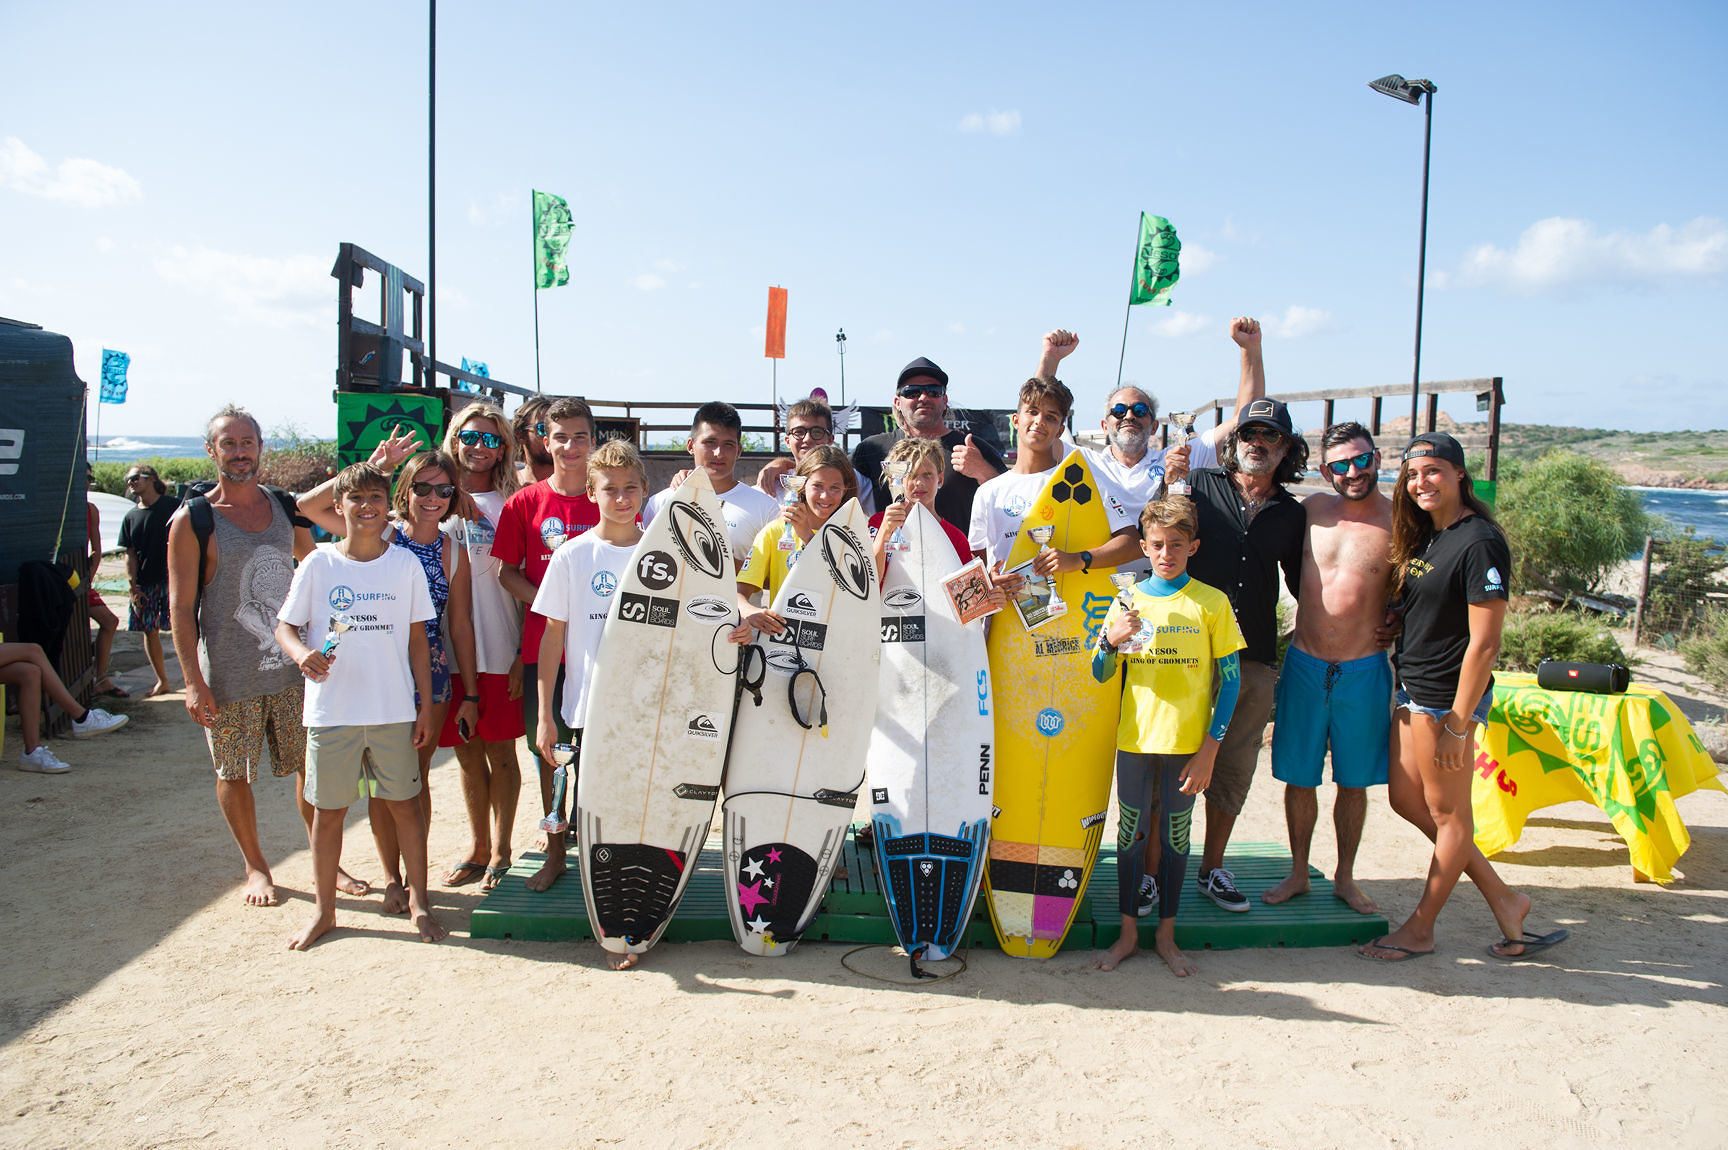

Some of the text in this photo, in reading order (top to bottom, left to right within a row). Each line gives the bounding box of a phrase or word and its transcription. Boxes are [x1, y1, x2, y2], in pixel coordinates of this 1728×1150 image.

[690, 501, 730, 560] BREAK POINT
[842, 525, 875, 583] BREAK POINT
[356, 592, 397, 601] SURFING
[652, 605, 671, 614] SOUL
[786, 607, 817, 617] QUIKSILVER
[801, 628, 819, 638] SOUL
[1156, 625, 1200, 634] SURFING
[1148, 648, 1179, 656] NESOS
[1158, 657, 1199, 665] GROMMETS
[977, 669, 989, 716] FCS
[687, 729, 718, 738] QUIKSILVER
[979, 743, 991, 795] PENN
